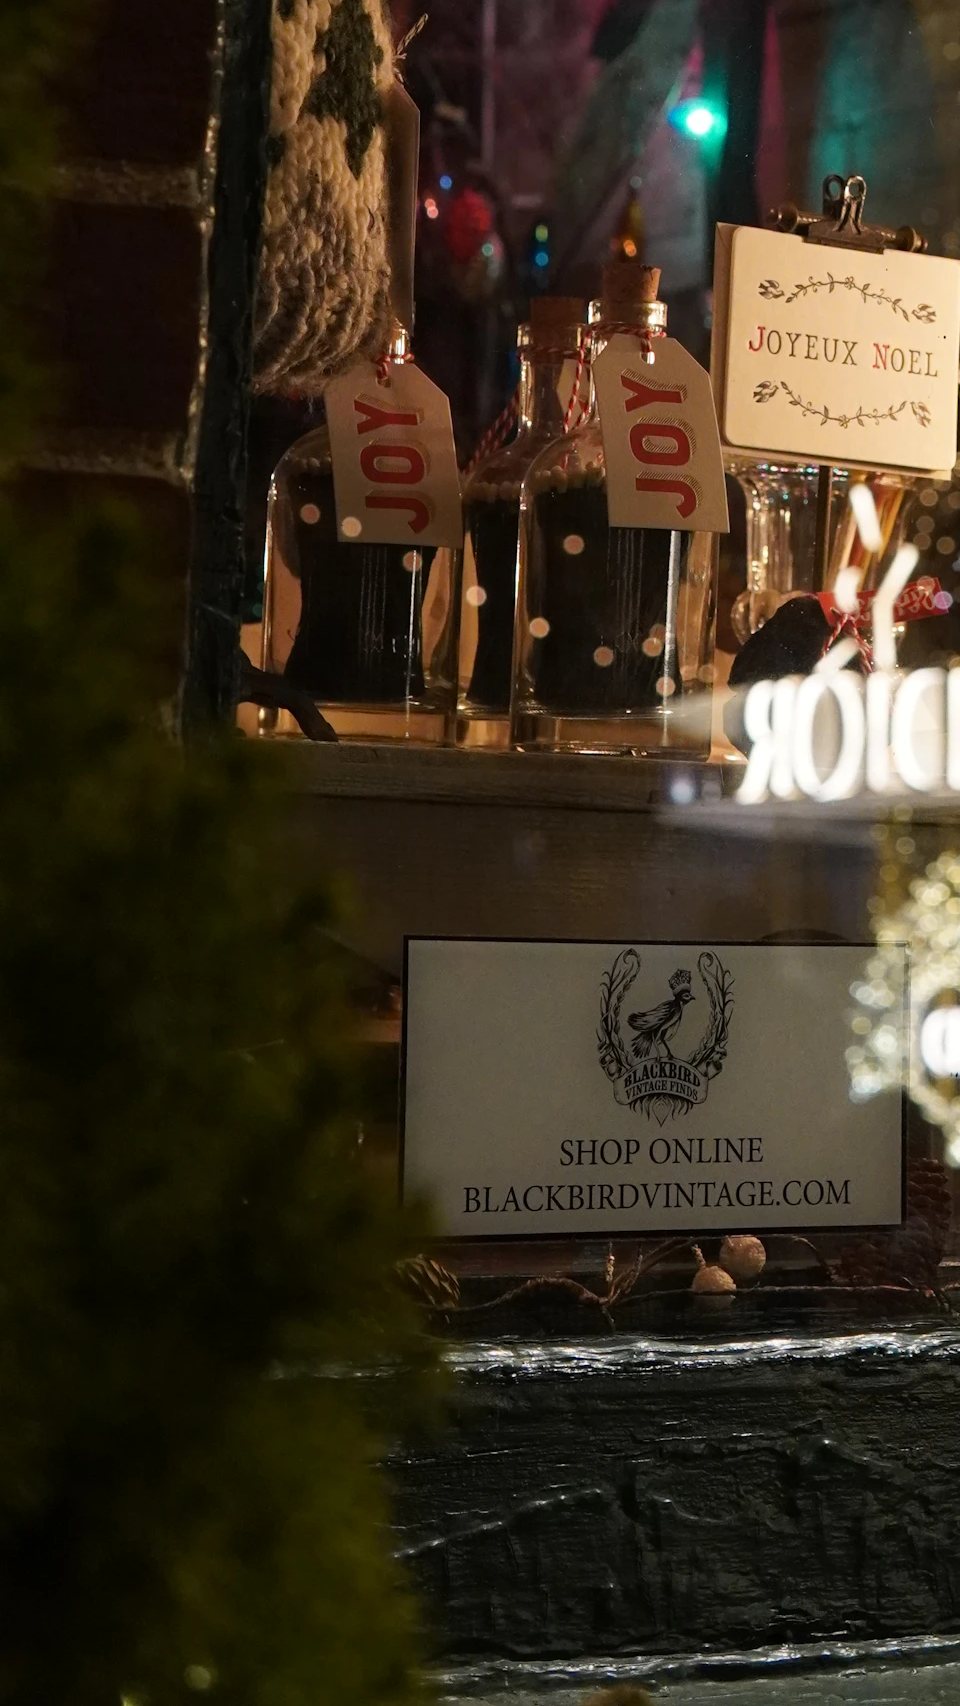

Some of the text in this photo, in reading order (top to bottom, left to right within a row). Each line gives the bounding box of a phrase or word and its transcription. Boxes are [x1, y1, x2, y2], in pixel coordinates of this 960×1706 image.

[748, 326, 938, 378] JOYEUX NOEL
[620, 367, 703, 519] JOY
[354, 394, 434, 534] JOY
[624, 1061, 700, 1088] BLACKBIRD
[625, 1079, 698, 1101] VINTAGE FINDS
[559, 1137, 764, 1166] SHOP ONLINE
[462, 1179, 852, 1213] BLACKBIRDVINTAGE.COM
